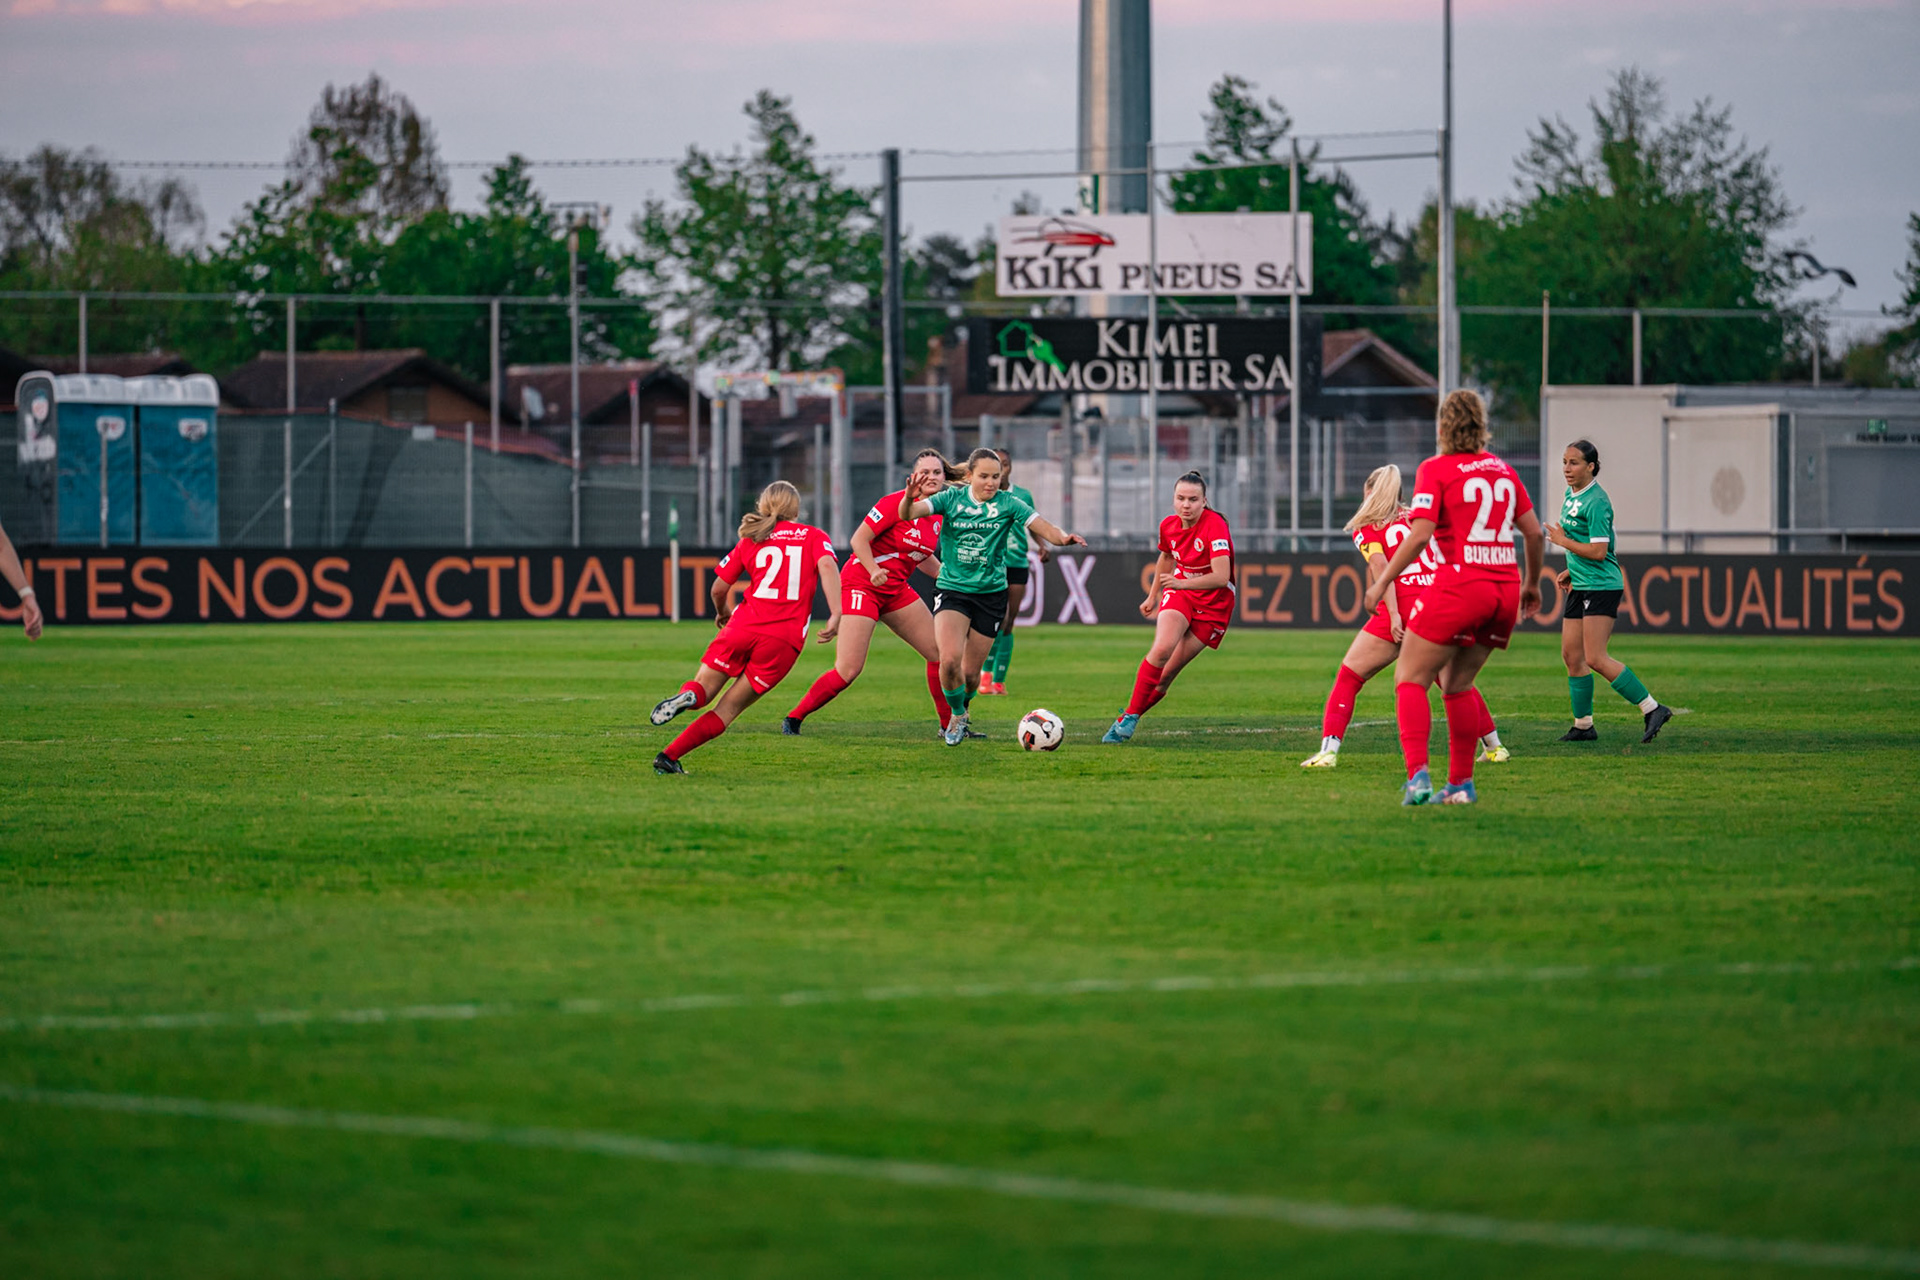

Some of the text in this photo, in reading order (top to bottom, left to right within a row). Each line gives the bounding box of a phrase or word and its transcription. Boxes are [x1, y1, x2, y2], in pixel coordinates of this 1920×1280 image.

[1120, 263, 1242, 290] PNEUS
[1256, 262, 1305, 289] SA
[988, 354, 1293, 392] IMMOBILIER SA
[1463, 477, 1517, 543] 22
[198, 556, 354, 620] NOS
[752, 545, 803, 600] 21
[851, 593, 863, 610] 11
